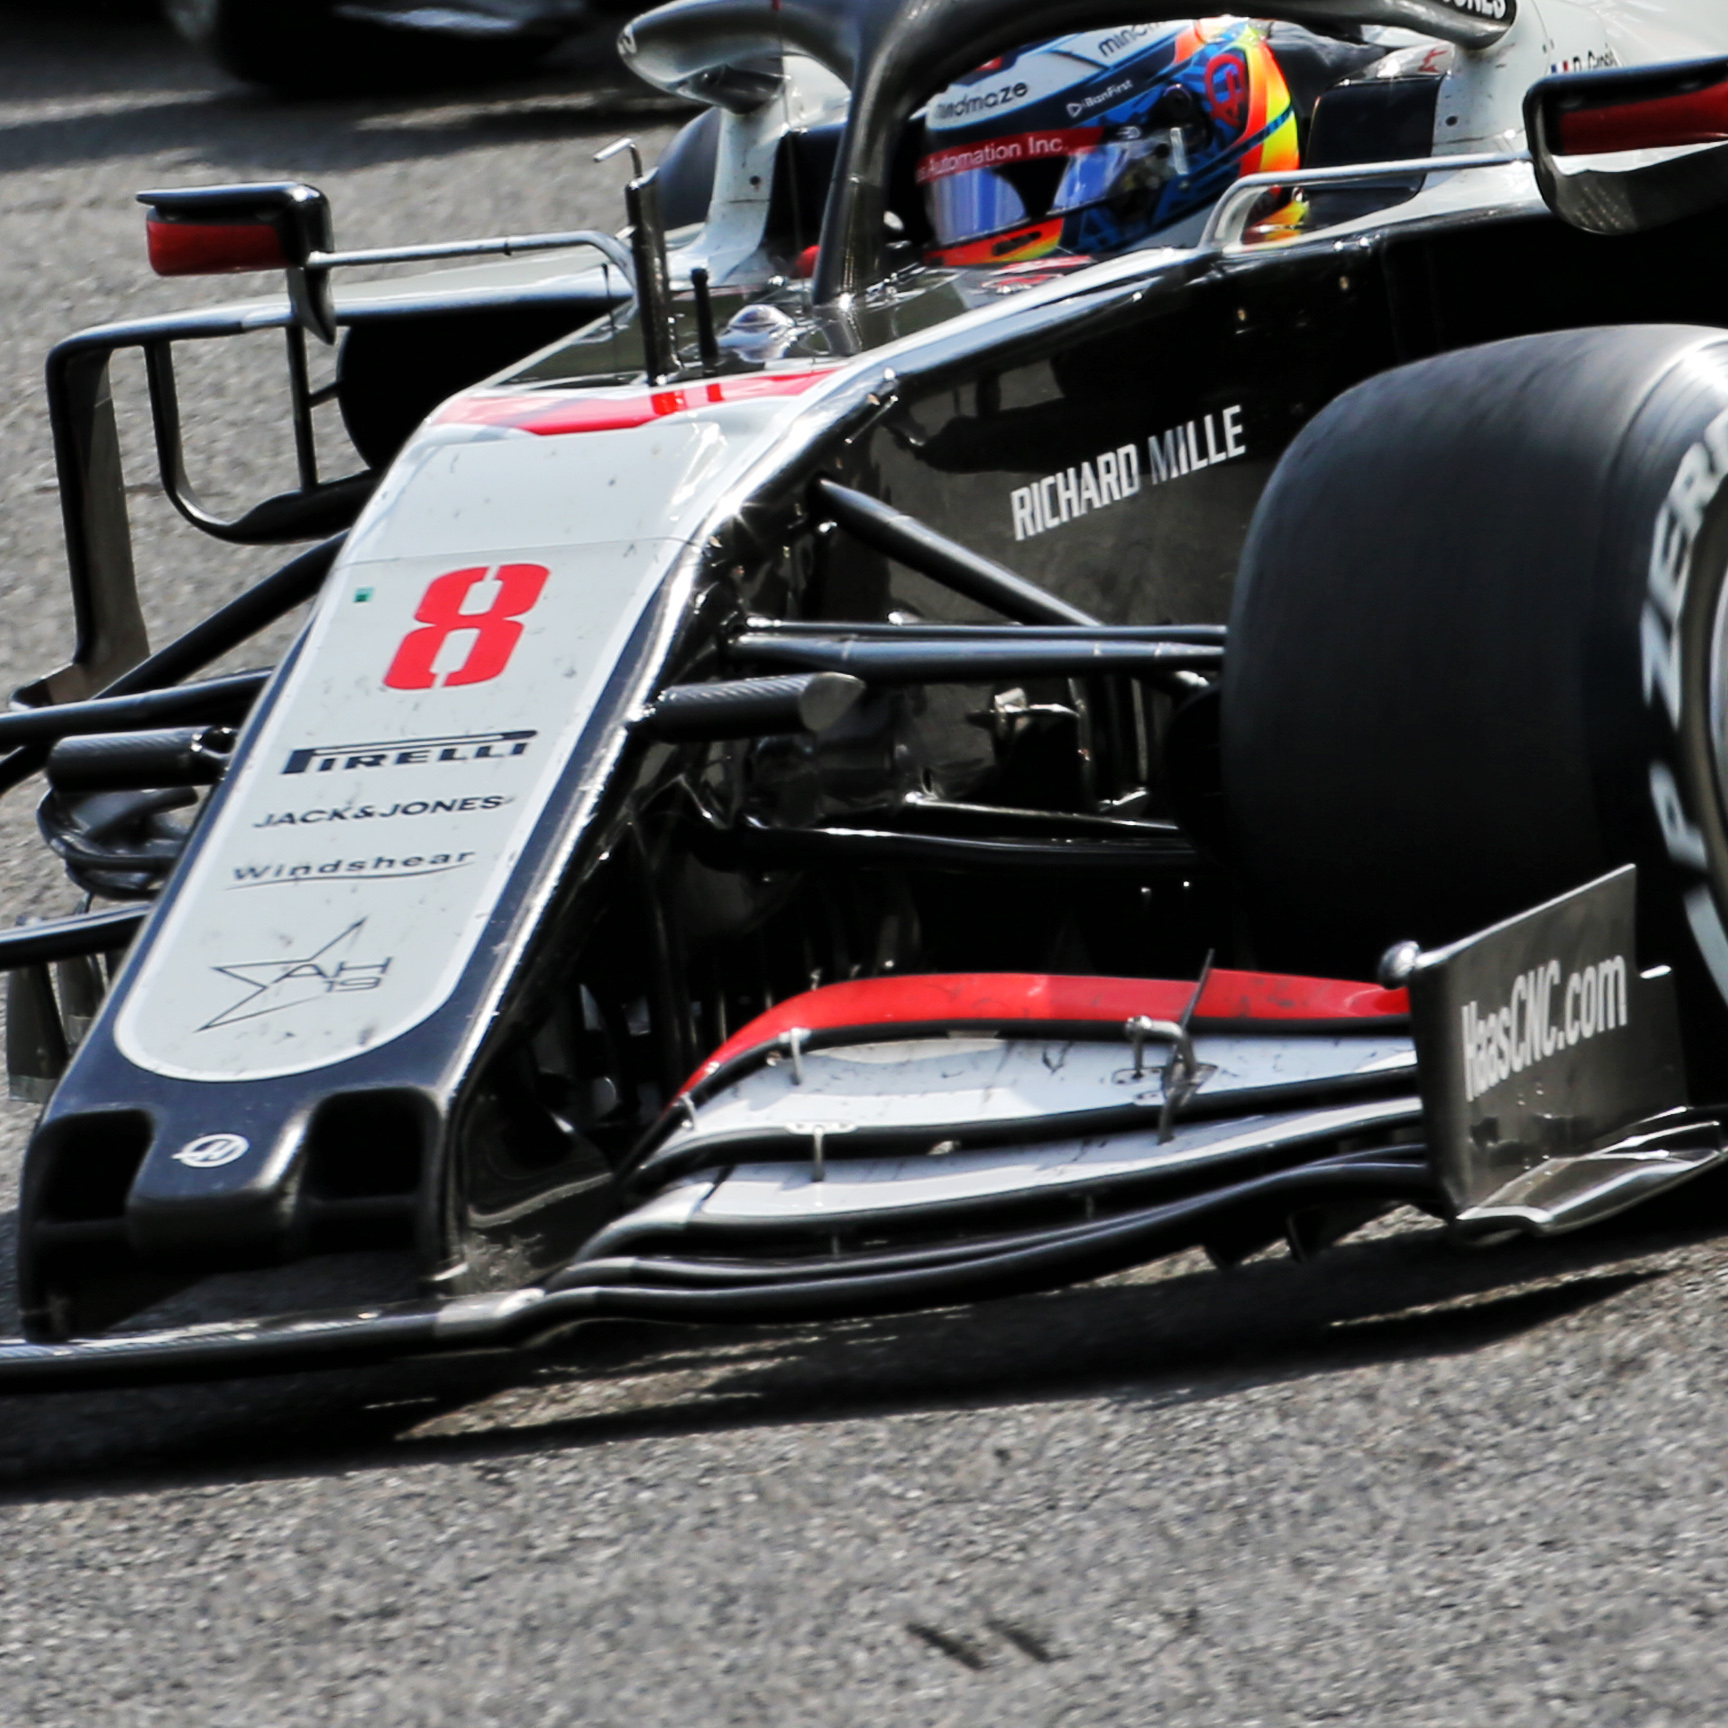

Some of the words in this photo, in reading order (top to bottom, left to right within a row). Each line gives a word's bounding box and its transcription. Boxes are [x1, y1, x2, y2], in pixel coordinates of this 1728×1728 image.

[1010, 442, 1140, 542] RICHARD
[1147, 404, 1247, 486] MILLE
[383, 562, 551, 690] 8
[281, 730, 538, 774] PIRELLI
[252, 795, 510, 828] JACK&JONES
[234, 851, 476, 881] Windshear
[1461, 955, 1628, 1102] HaasCNC.com
